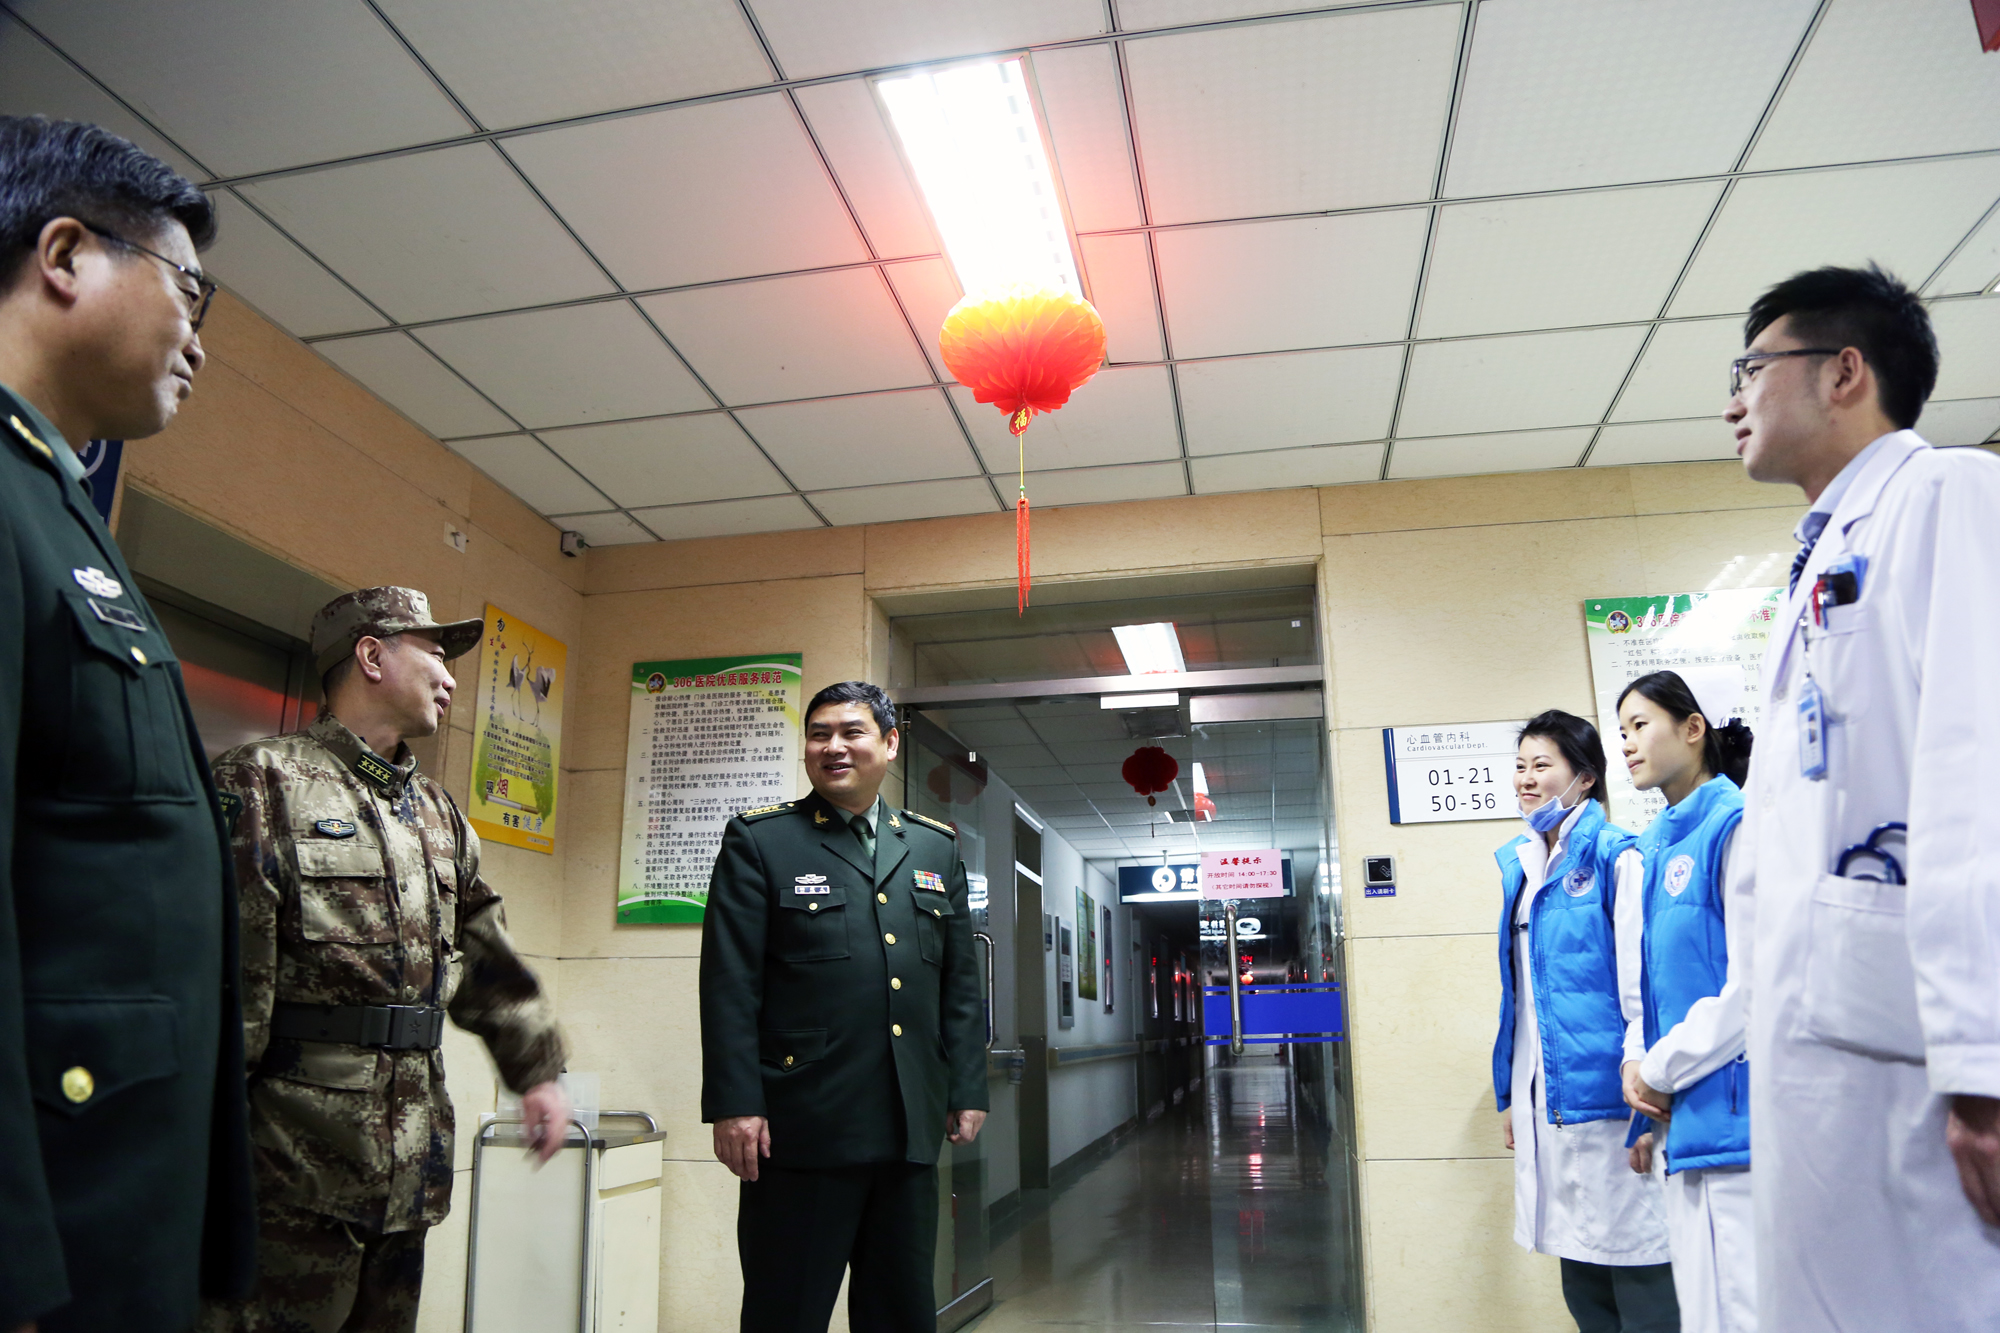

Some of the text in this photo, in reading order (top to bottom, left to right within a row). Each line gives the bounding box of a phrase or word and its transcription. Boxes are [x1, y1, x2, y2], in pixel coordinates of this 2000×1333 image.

[1014, 408, 1028, 430] 福
[1406, 732, 1470, 744] 心血管内科
[1428, 767, 1494, 786] 01-21
[1432, 793, 1496, 812] 50-56
[1220, 856, 1262, 866] 温馨提示
